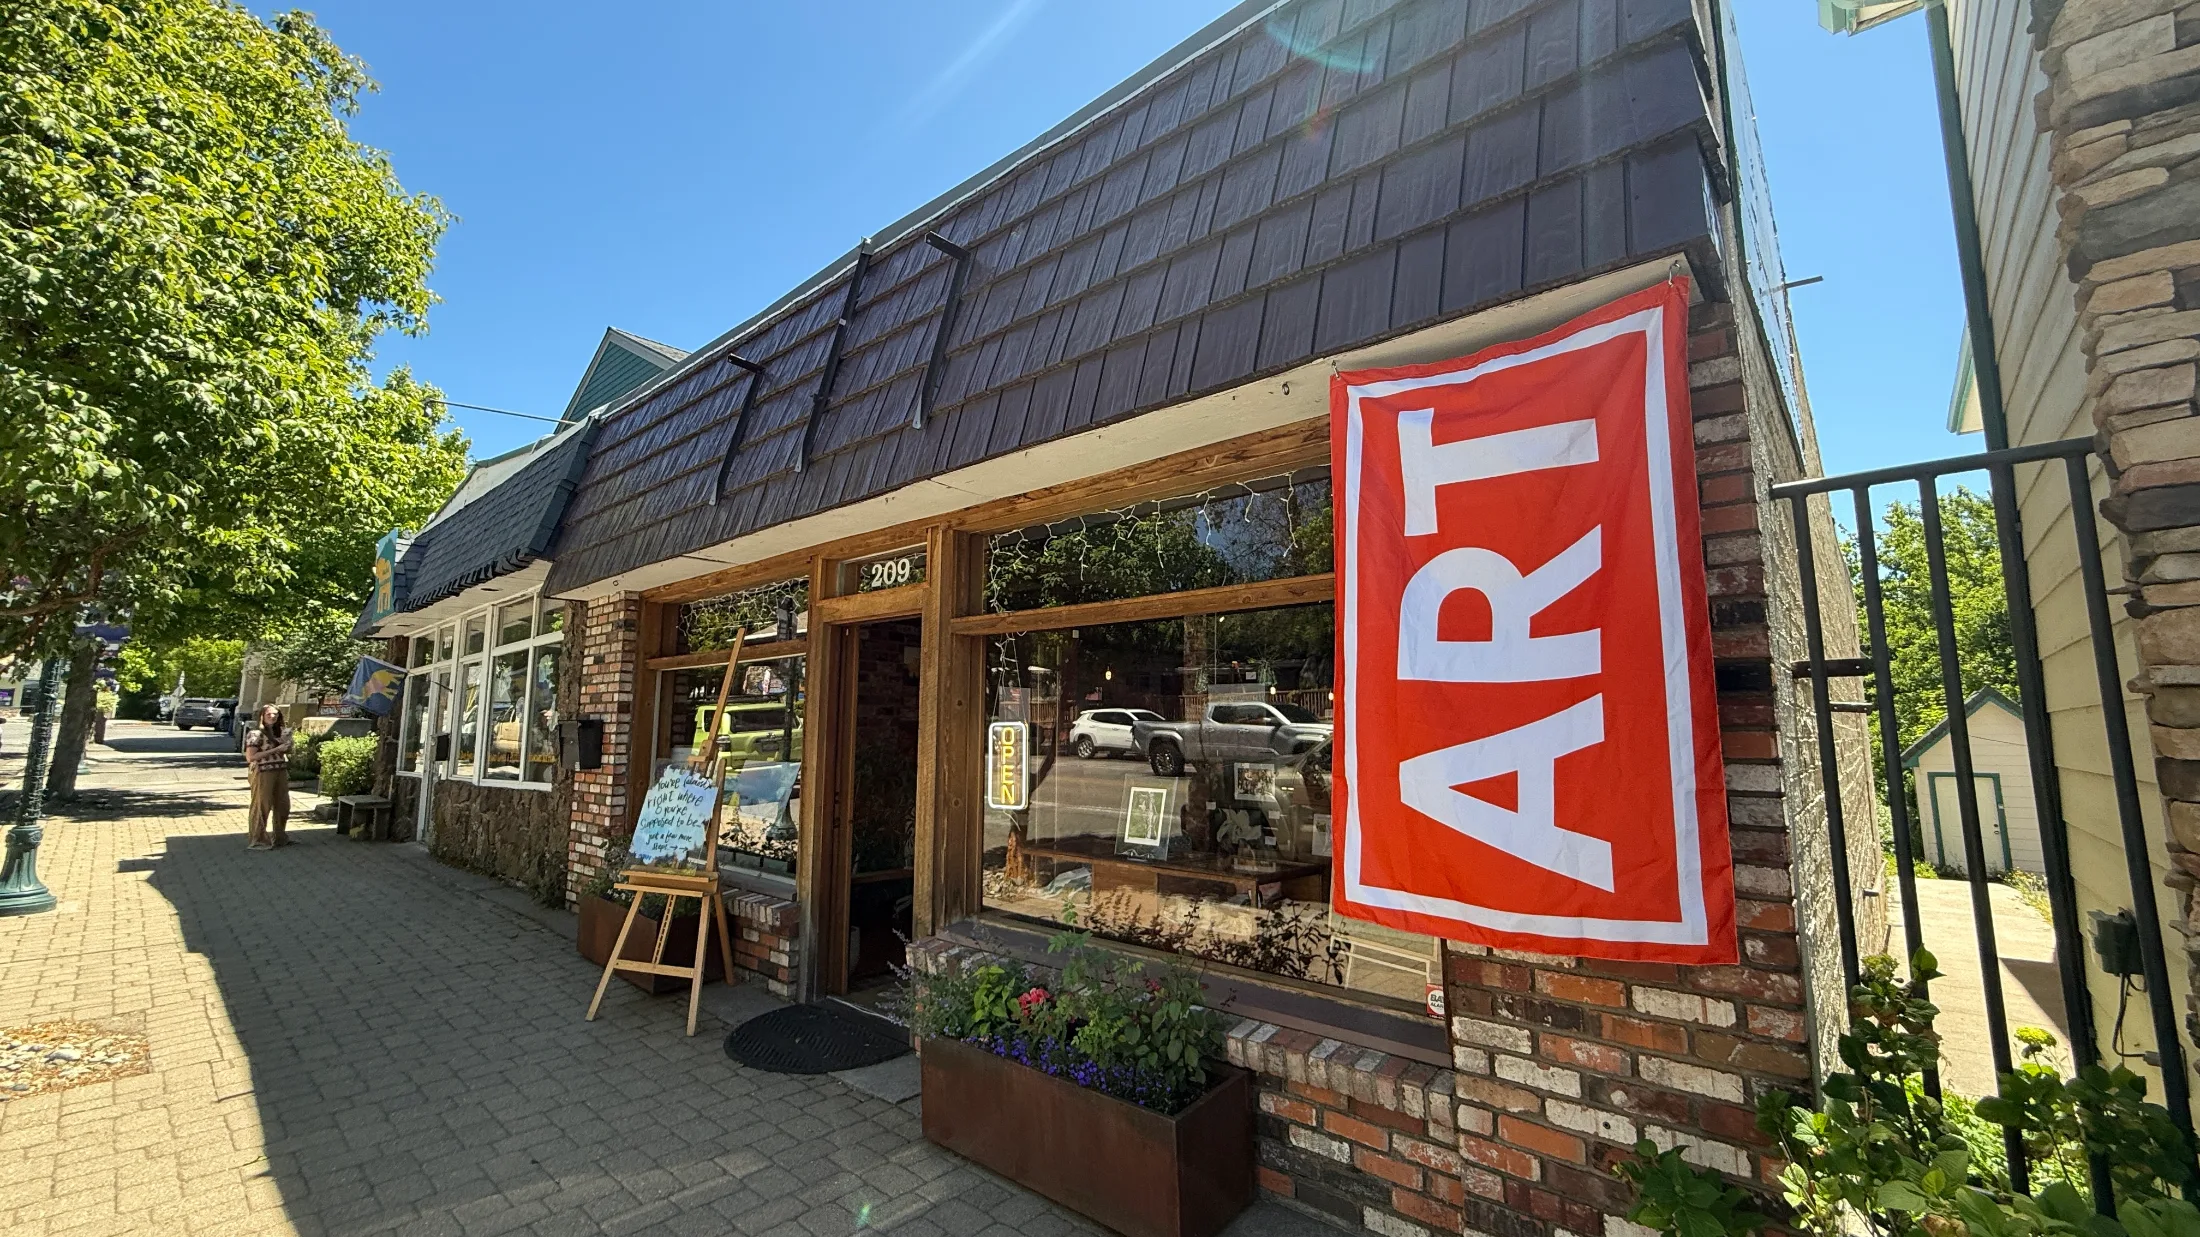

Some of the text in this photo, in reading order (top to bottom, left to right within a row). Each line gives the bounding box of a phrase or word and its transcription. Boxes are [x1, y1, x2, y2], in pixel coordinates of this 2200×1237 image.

[871, 558, 910, 587] 209
[1397, 408, 1615, 893] ART
[1001, 727, 1015, 804] OPEN
[677, 790, 704, 807] where
[676, 816, 685, 827] to
[1430, 994, 1444, 1003] BA
